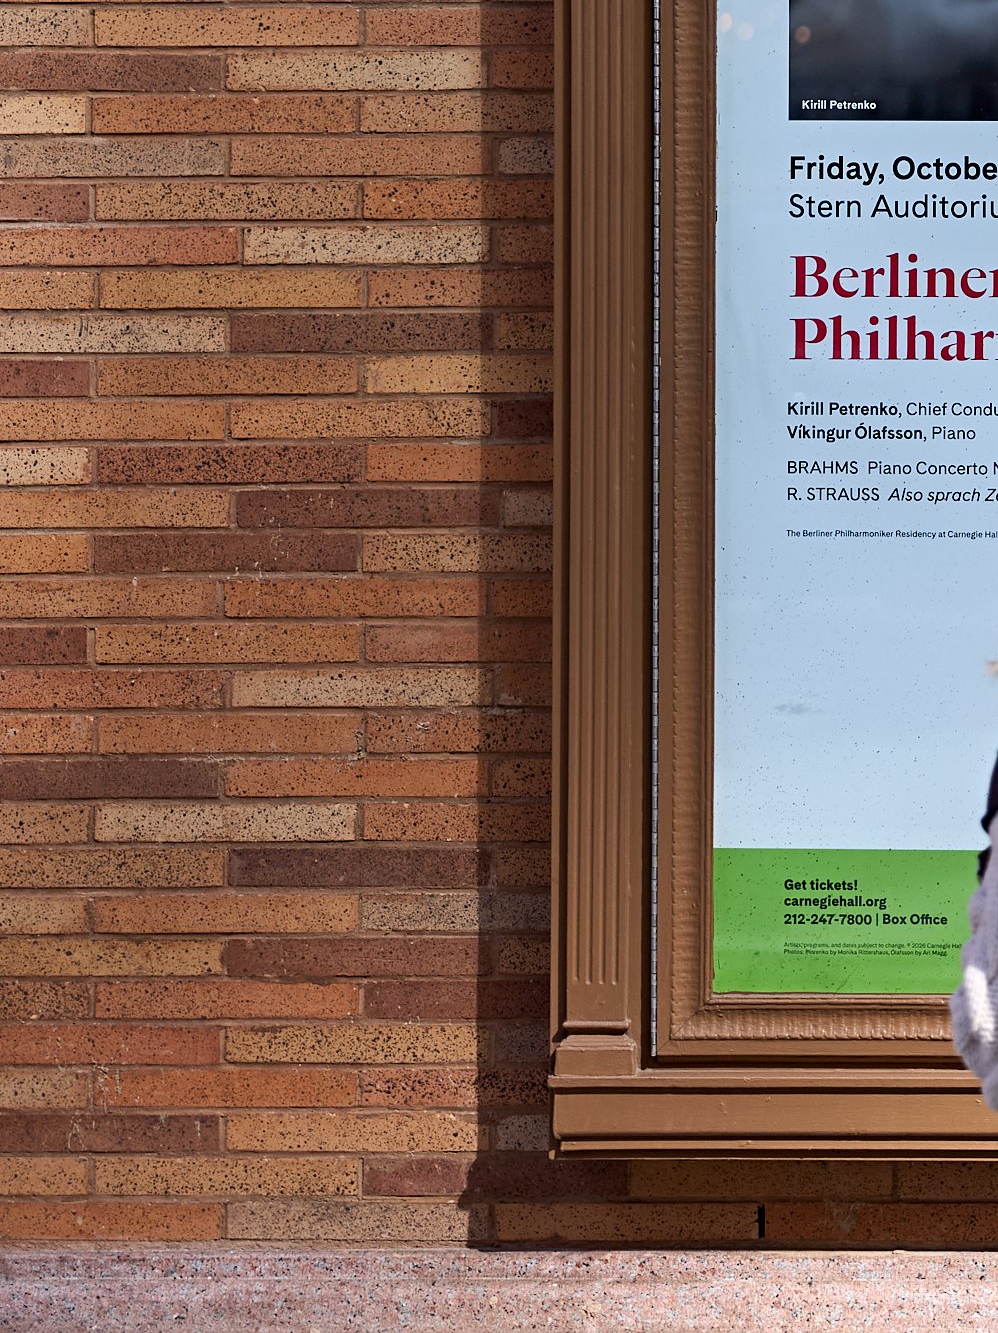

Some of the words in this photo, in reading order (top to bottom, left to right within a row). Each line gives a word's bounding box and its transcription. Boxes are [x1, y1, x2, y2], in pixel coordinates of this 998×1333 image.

[801, 99, 827, 110] Kirill
[829, 99, 877, 110] Petrenko
[790, 155, 885, 185] Friday,
[788, 193, 862, 219] Stern
[787, 401, 824, 416] Kirill
[829, 401, 902, 419] Petrenko,
[906, 402, 948, 416] Chief
[787, 423, 852, 443] Víkingur
[854, 422, 927, 443] Ólafsson,
[932, 425, 977, 440] Piano
[787, 460, 859, 475] BRAHMS
[868, 460, 912, 475] Piano
[915, 461, 988, 476] Concerto
[787, 487, 802, 502] R.
[806, 487, 880, 502] STRAUSS
[888, 487, 924, 502] Also
[927, 487, 981, 506] sprach
[786, 529, 801, 538] The
[803, 529, 833, 539] Berliner
[834, 529, 894, 539] Philharmoniker
[895, 529, 937, 541] Residency
[938, 530, 947, 539] at
[948, 530, 983, 541] Carnegie
[784, 878, 807, 891] Get
[809, 878, 858, 891] tickets!
[784, 895, 887, 910] carnegiehall.org
[784, 913, 873, 926] 212-247-7800
[882, 913, 908, 926] Box
[909, 913, 948, 926] Office
